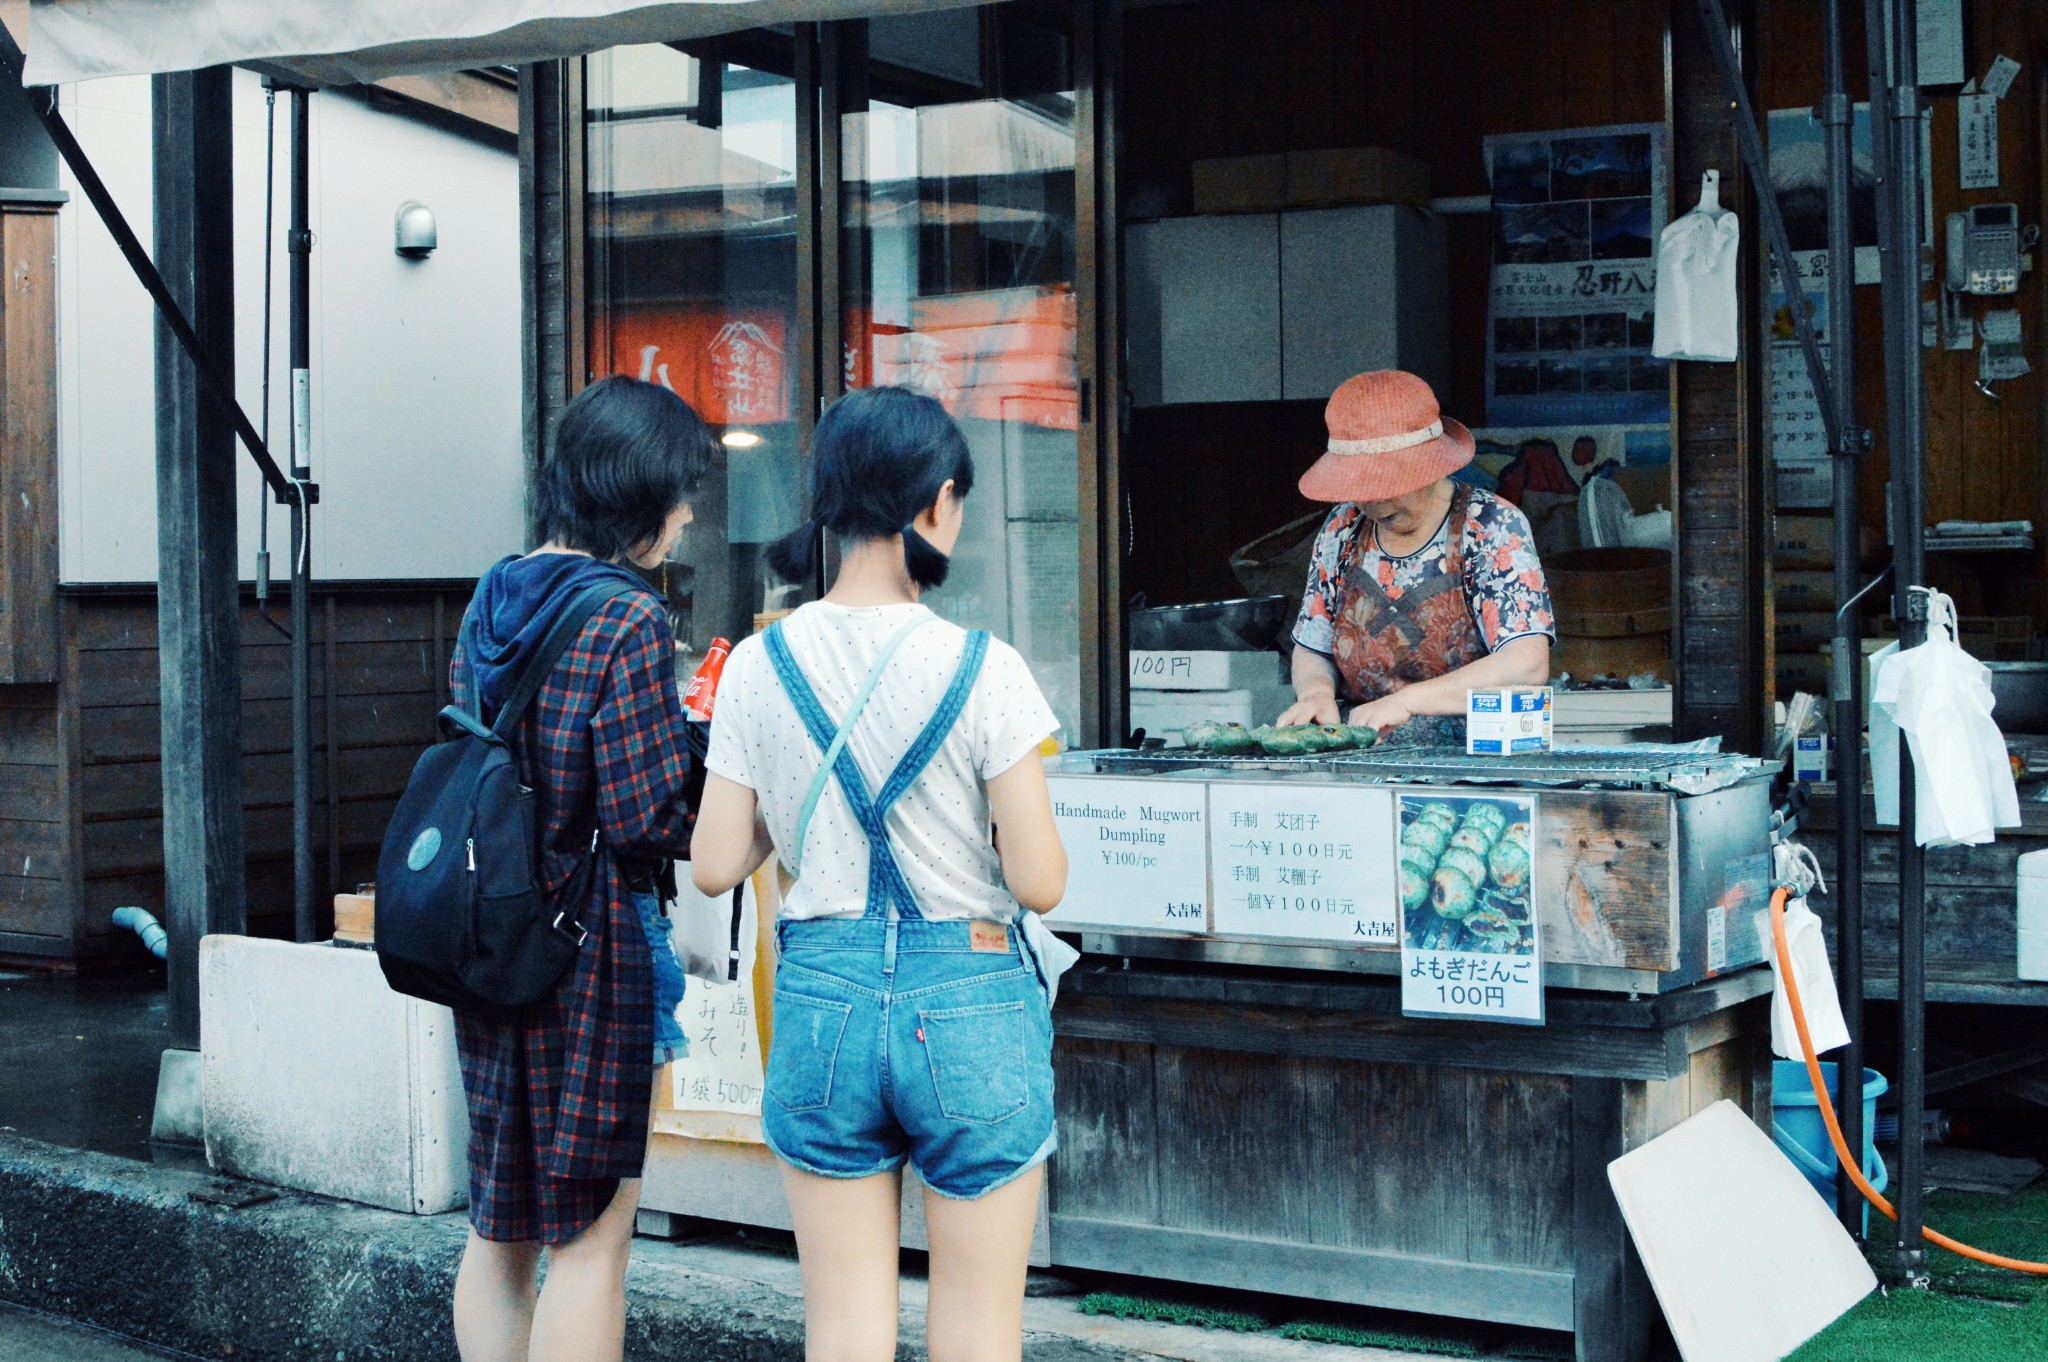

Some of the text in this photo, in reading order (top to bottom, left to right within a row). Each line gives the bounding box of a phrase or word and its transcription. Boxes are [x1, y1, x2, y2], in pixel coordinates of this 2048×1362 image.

[1133, 656, 1192, 678] 100円
[1055, 802, 1201, 824] Handmade Mugwort
[1229, 811, 1320, 831] 手制 艾团子
[1099, 826, 1166, 845] Dumpling
[1101, 850, 1157, 868] ¥100/pc
[1231, 865, 1260, 882] 手制
[1164, 902, 1202, 918] 大吉屋
[1353, 920, 1395, 938] 大吉屋
[1410, 956, 1532, 984] よもぎだんご
[1437, 985, 1504, 1008] 100円
